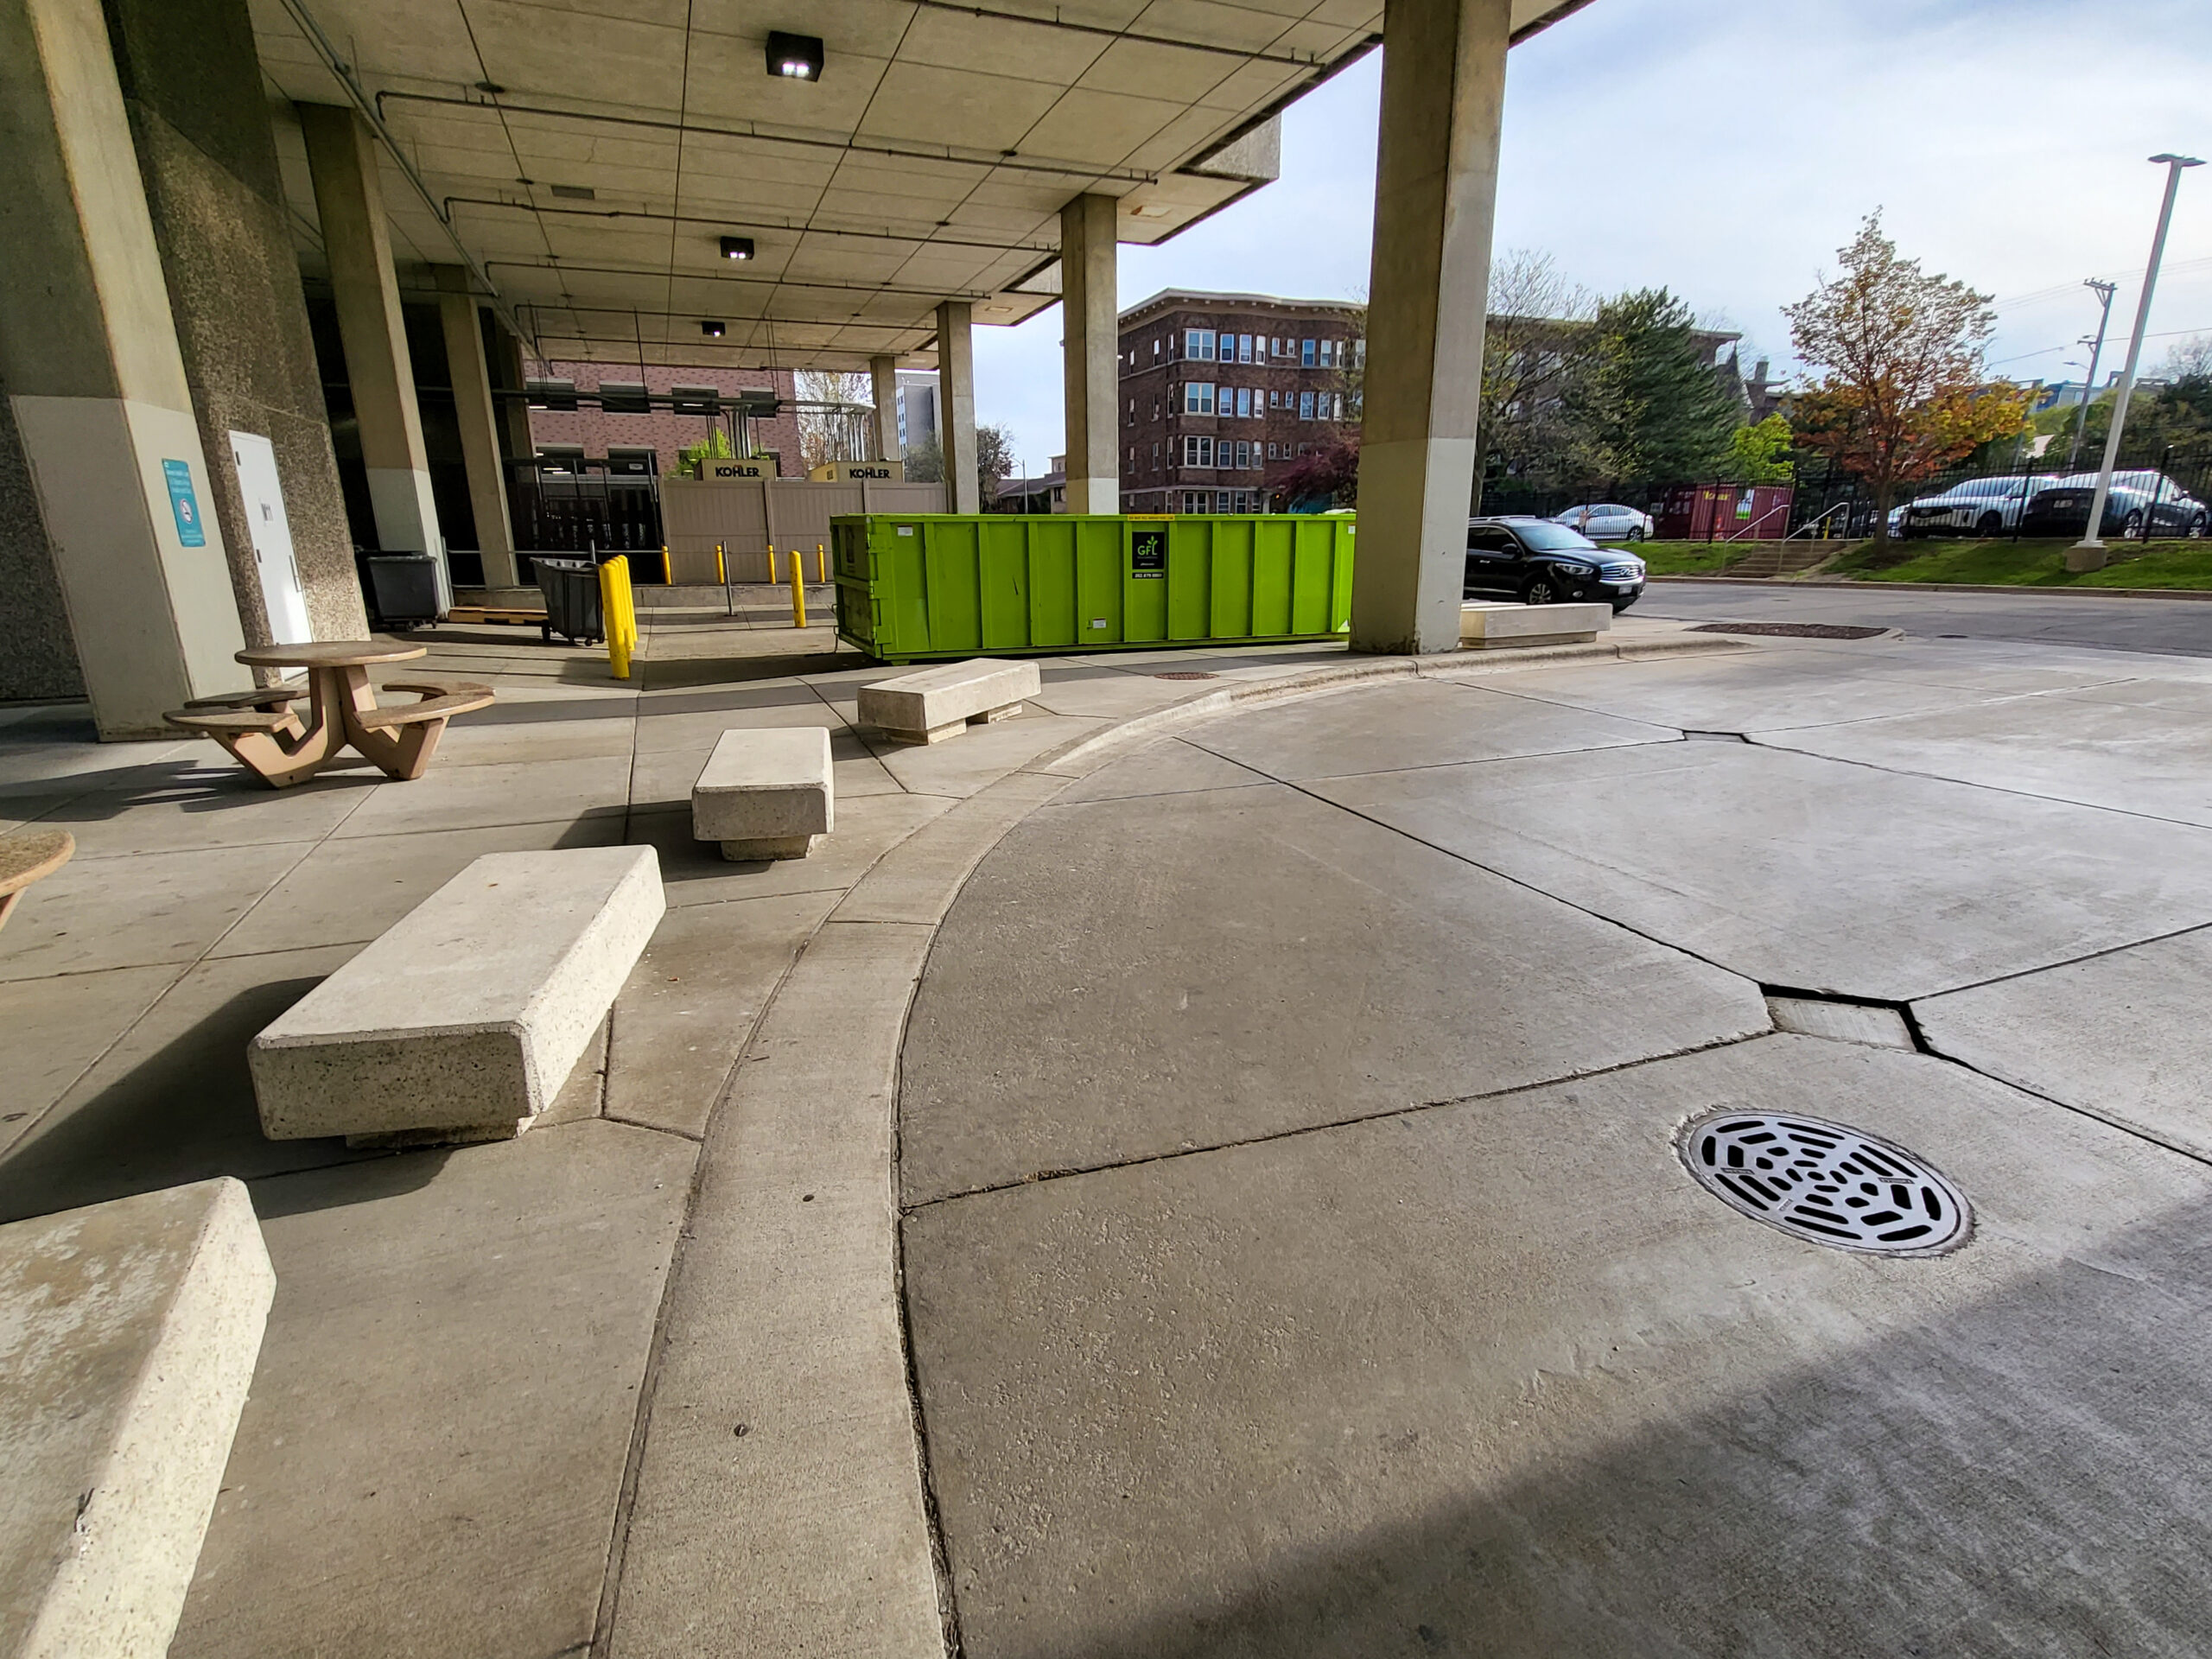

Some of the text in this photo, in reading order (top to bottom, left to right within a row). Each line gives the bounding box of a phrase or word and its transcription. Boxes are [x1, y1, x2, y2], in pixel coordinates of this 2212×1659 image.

[715, 467, 760, 477] KOHLER
[849, 468, 890, 479] KOHLER
[1137, 542, 1158, 556] GFL
